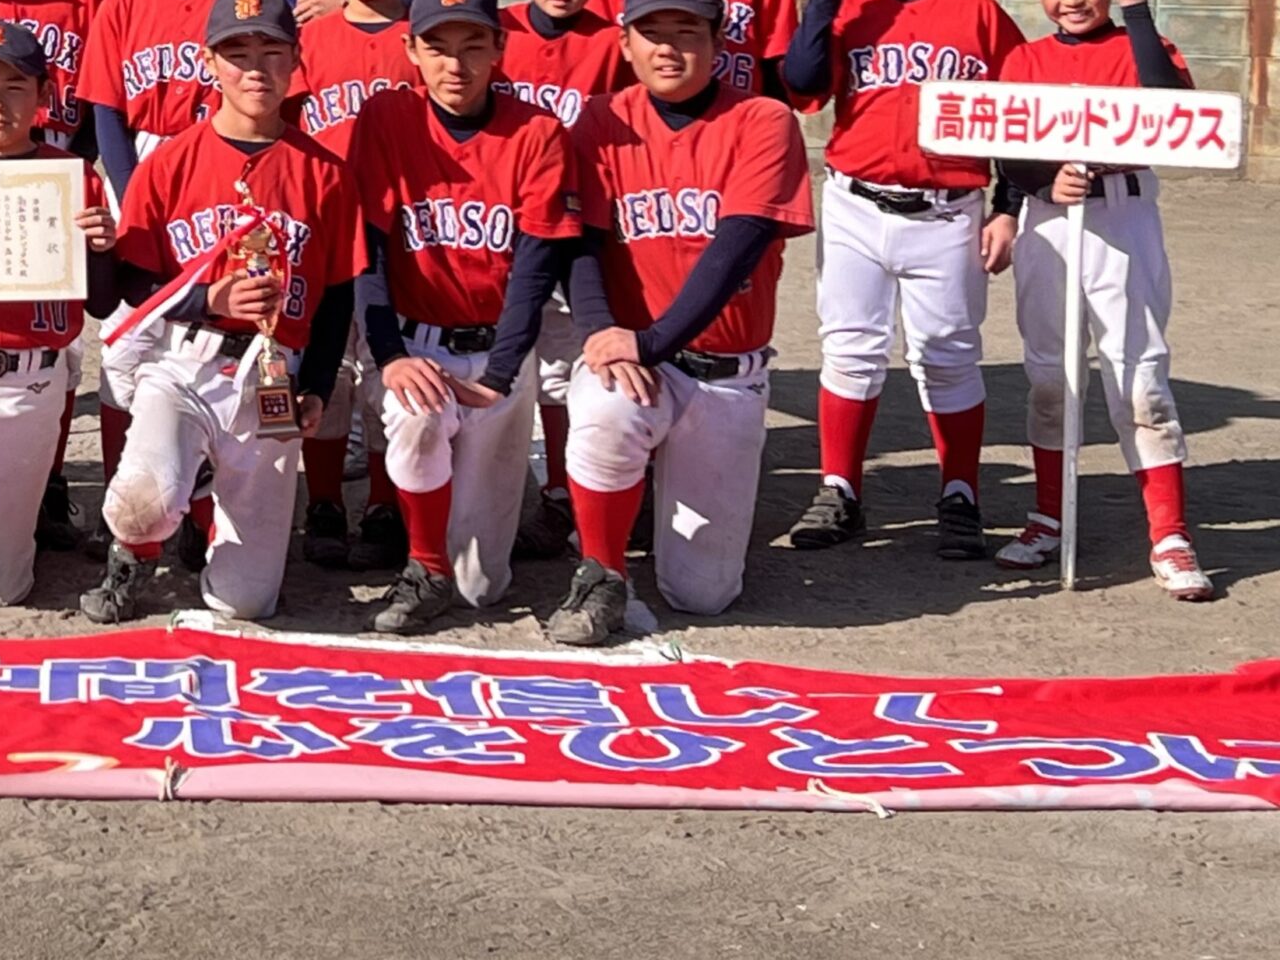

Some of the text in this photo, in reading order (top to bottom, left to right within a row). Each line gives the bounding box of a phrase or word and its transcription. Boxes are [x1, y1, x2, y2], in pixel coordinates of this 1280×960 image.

[123, 42, 220, 100] REDS
[848, 42, 988, 92] EDSO
[303, 77, 412, 136] RED
[934, 92, 1226, 151] 高舟台レッドソックス
[401, 197, 514, 253] REDSO
[615, 188, 721, 243] EDSO
